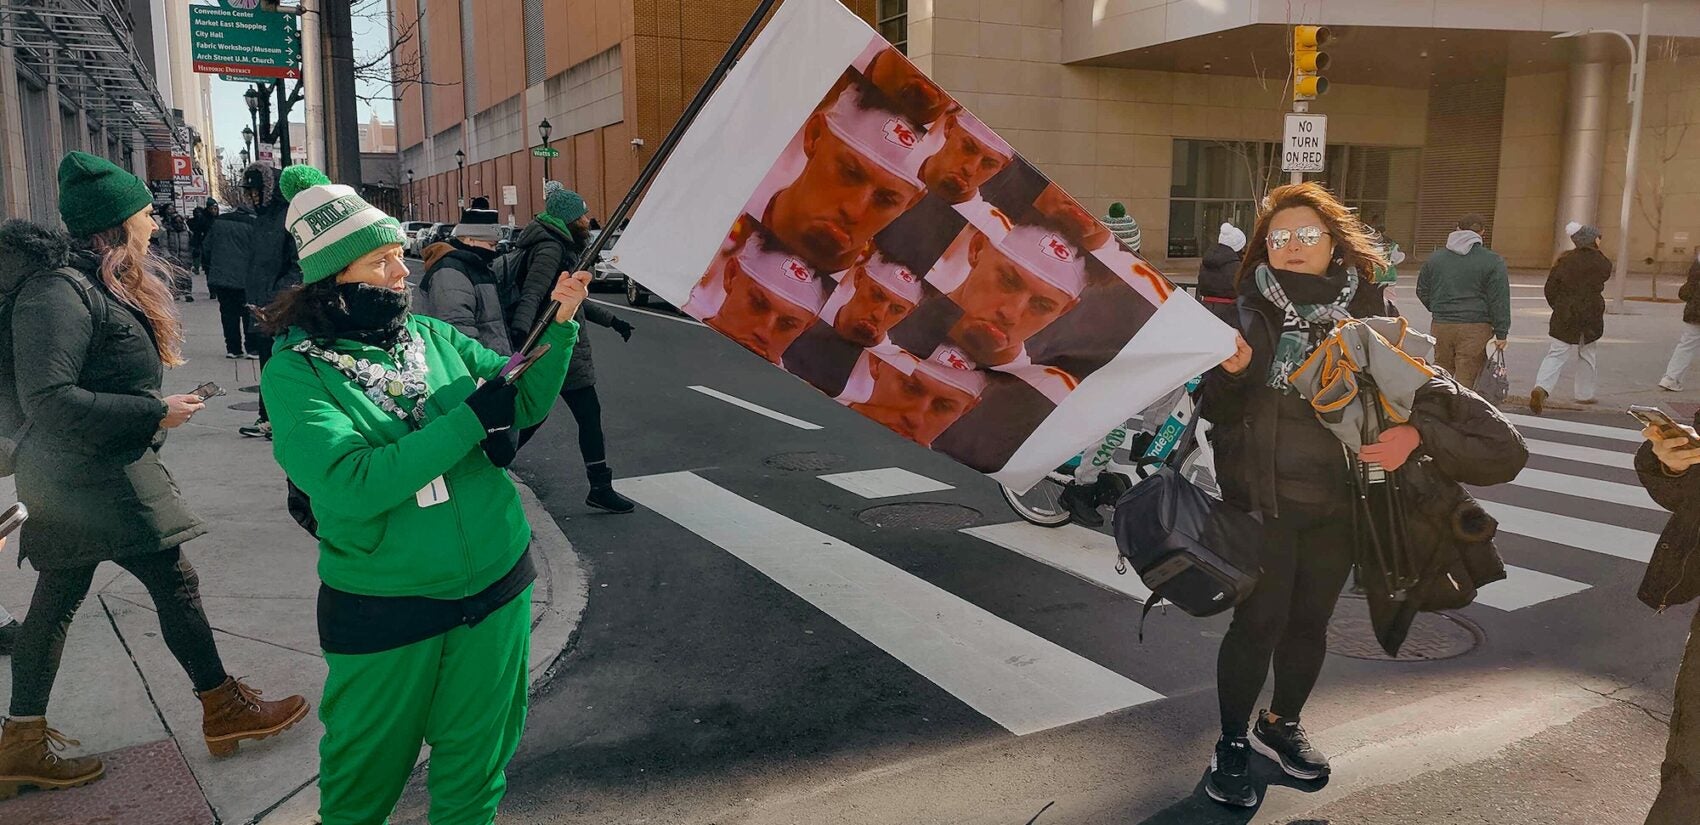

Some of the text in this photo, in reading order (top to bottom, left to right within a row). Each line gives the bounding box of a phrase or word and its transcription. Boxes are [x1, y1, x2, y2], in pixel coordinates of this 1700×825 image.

[193, 7, 254, 18] Convention Center
[194, 19, 267, 31] Market East Shopping
[195, 30, 224, 39] City Hall
[196, 41, 282, 54] Fabric Workshop/Museum
[196, 53, 212, 61] Arch
[213, 54, 234, 62] Street
[251, 57, 275, 65] Church
[1299, 121, 1312, 132] NO
[1292, 137, 1318, 147] TURN
[1286, 152, 1321, 162] ON RED
[173, 158, 187, 175] P
